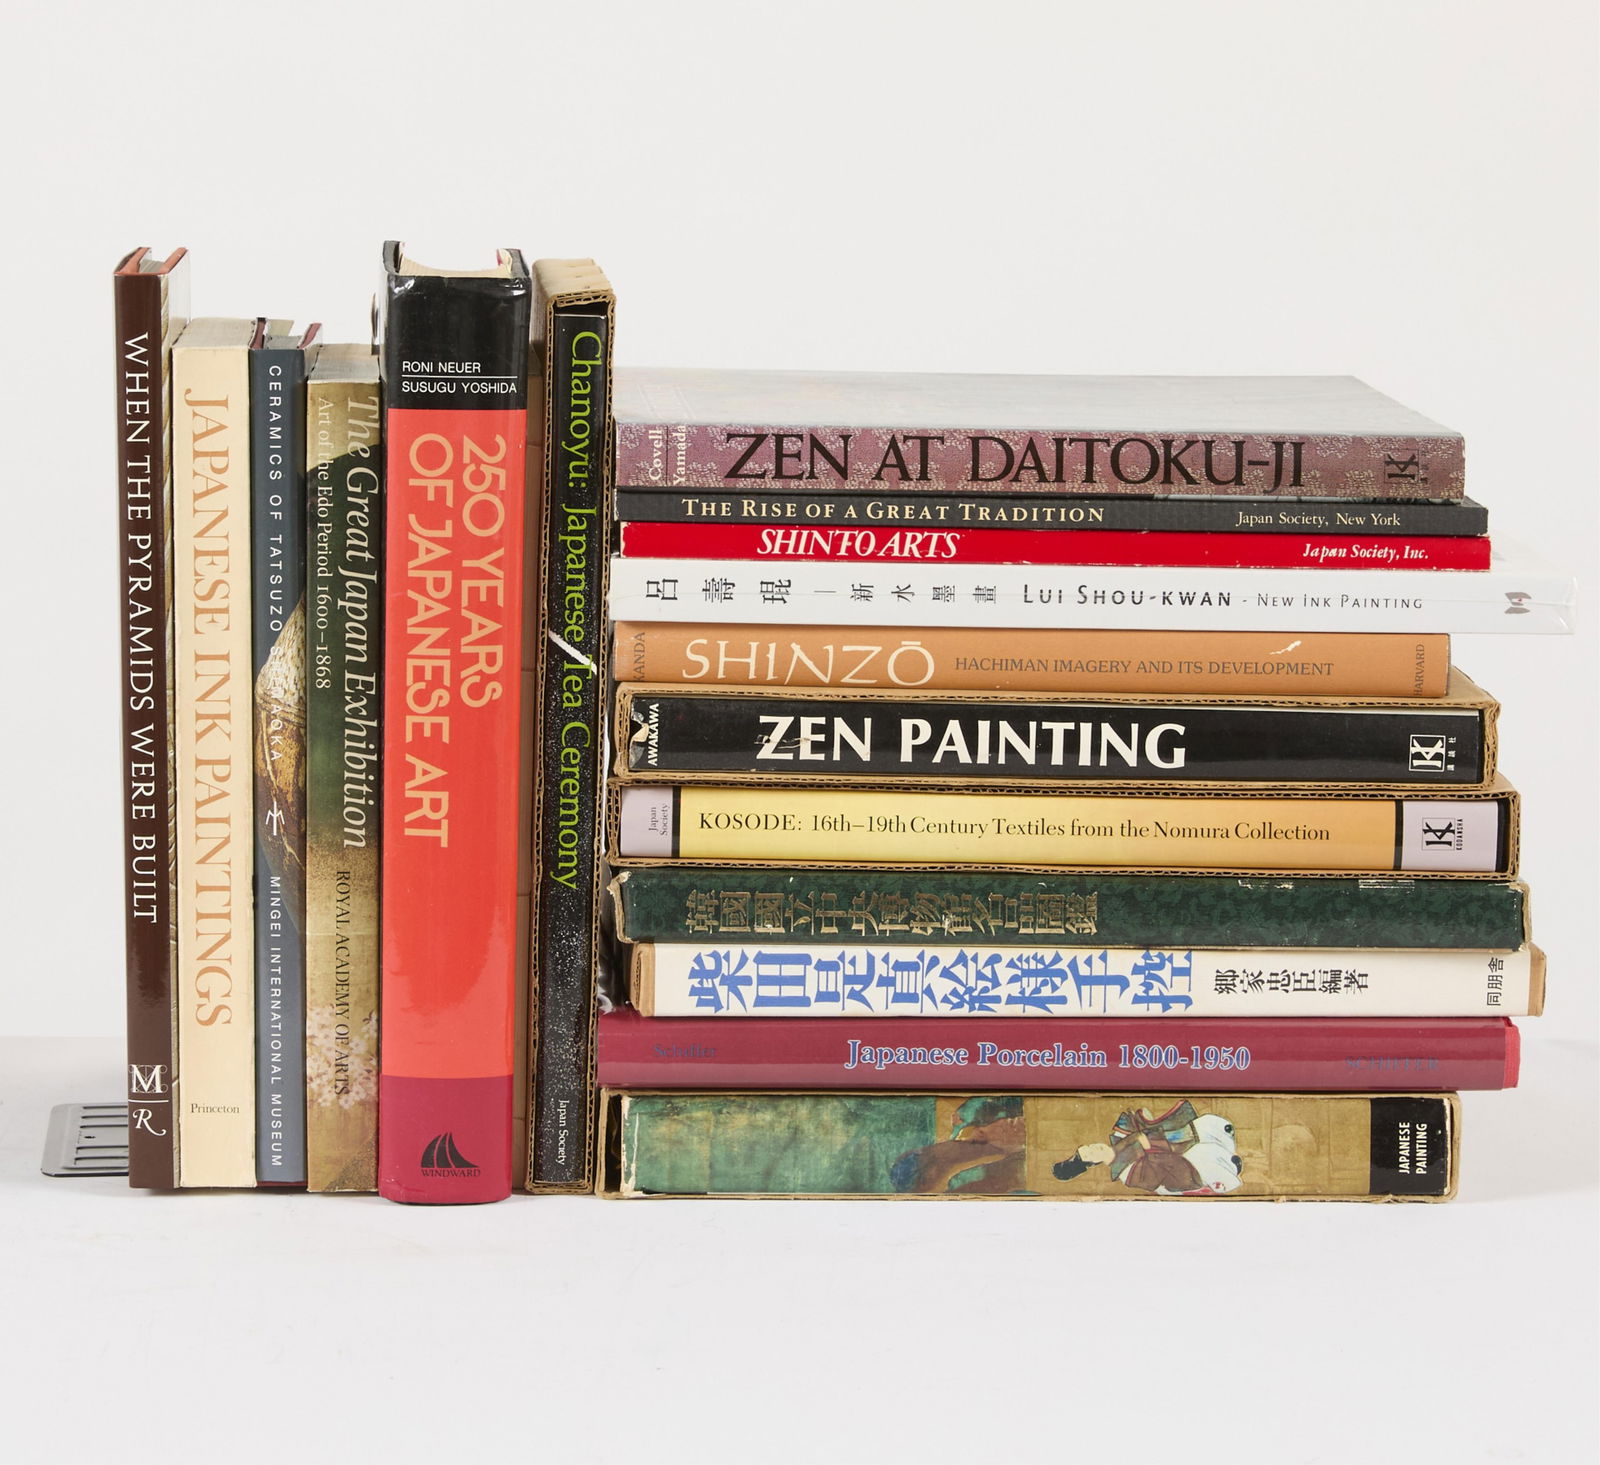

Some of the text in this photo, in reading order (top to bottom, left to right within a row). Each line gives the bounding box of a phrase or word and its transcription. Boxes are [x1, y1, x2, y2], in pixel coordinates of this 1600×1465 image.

[402, 361, 481, 373] RONI NEUER
[402, 381, 517, 394] SUSUGU YOSHIDA
[318, 398, 334, 425] Art
[317, 449, 334, 481] the
[318, 430, 334, 450] of
[648, 427, 666, 481] Covell
[673, 423, 687, 486] Yamada
[724, 433, 1305, 494] ZEN AT DAITOKU-JI
[317, 486, 334, 518] Edo
[1235, 511, 1401, 528] Japan Society, New York
[269, 365, 283, 761] CERAMICS OF TATSUZO SHIMAOKA
[317, 522, 333, 577] Period
[757, 529, 960, 558] SHINTO ARTS
[1303, 543, 1429, 562] Japan Society, Inc.
[460, 434, 507, 708] 250 YEARS
[850, 583, 997, 604] 新水墨畫
[124, 332, 157, 924] WHEN THE PYRAMIDS WERE BUILT
[337, 396, 380, 849] The Great Japan Exhibition
[551, 329, 602, 890] Chanoyu: Japanese Tea Ceremony
[404, 433, 454, 848] OF JAPANESE ART
[682, 639, 935, 686] SHINZŌ
[955, 656, 1333, 676] HACHIMAN IMAGERY AND ITS DEVELOPMENT
[1413, 643, 1425, 697] HARVARD
[184, 388, 233, 1027] JAPANESE INK PAINTINGS
[647, 703, 659, 766] AWAKAWA
[756, 715, 1186, 769] ZEN PAINTING
[648, 806, 658, 832] Japan
[659, 803, 669, 836] Society
[699, 812, 801, 831] KOSODE:
[910, 816, 987, 838] Century
[991, 817, 1064, 836] Textiles
[1071, 818, 1114, 838] from
[1120, 819, 1150, 838] the
[1153, 820, 1230, 840] Nomura
[1235, 821, 1331, 842] Collection
[1455, 818, 1464, 851] KODANSHA
[334, 871, 351, 1096] ROYAL ACADEMY OF ARTS
[688, 949, 1194, 1014] 柴田是真絵様手控
[270, 876, 282, 1166] MINGEI INTERNATIONAL MUSEUM
[843, 1039, 1250, 1070] Japanese Porcelain 1800-1950
[190, 1103, 240, 1114] Princeton
[555, 1099, 570, 1166] Japan Society
[421, 1168, 481, 1178] WINDWARD
[1399, 1121, 1411, 1175] JAPANESE
[1415, 1122, 1427, 1175] PAINTING
